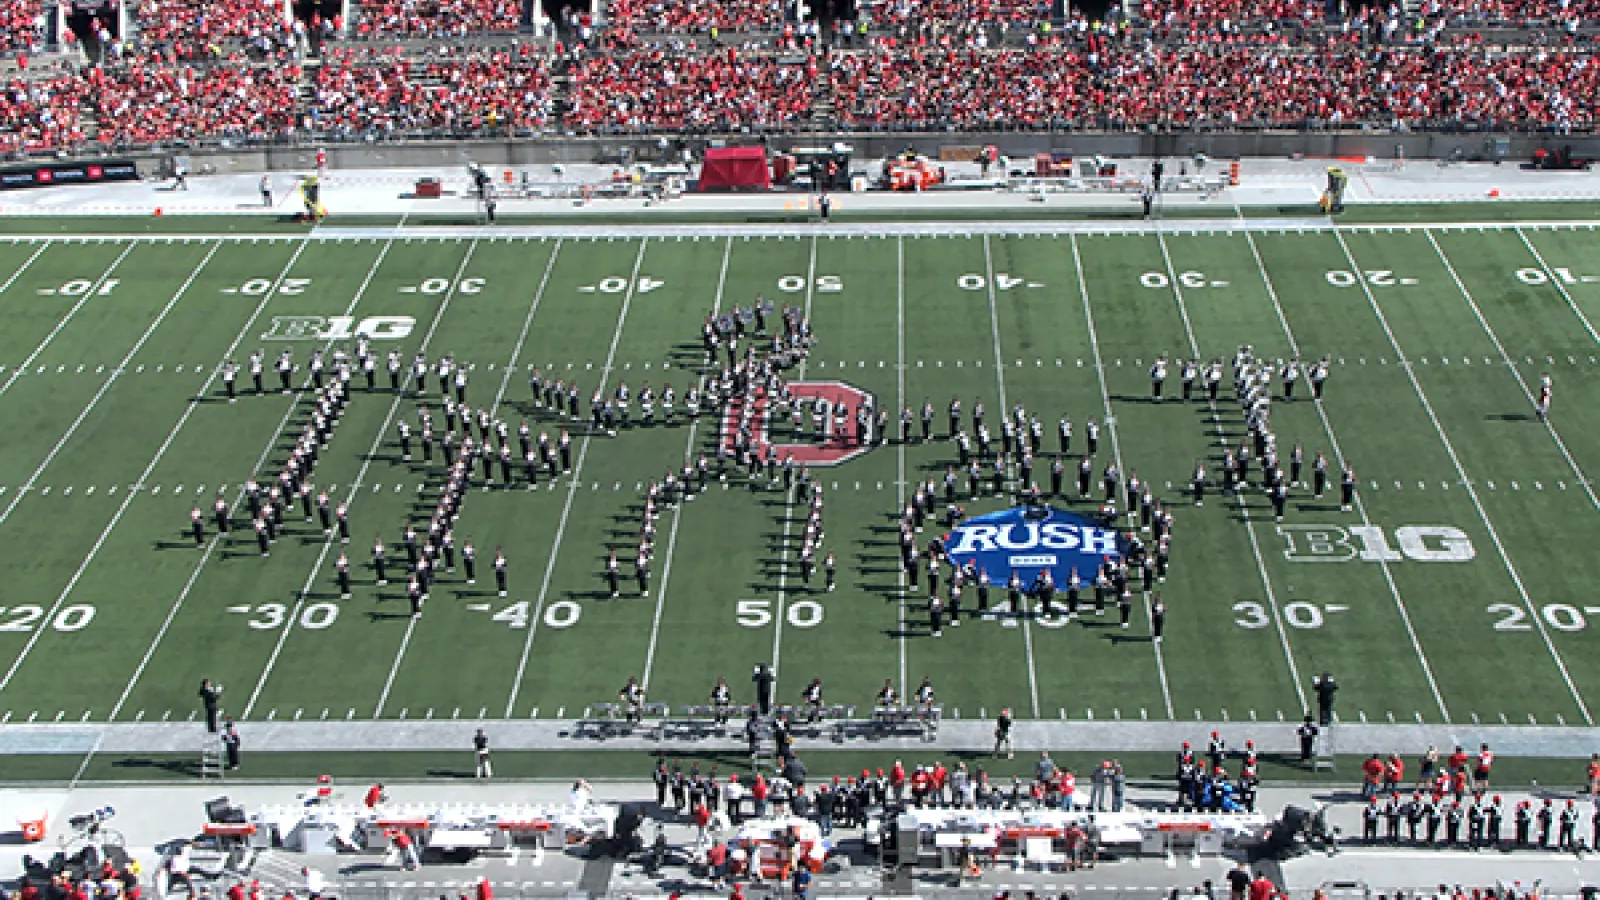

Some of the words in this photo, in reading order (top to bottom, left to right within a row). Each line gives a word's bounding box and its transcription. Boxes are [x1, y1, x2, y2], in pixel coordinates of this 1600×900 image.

[599, 275, 665, 292] 40
[778, 275, 843, 292] 50
[958, 273, 1024, 290] 40
[1140, 271, 1206, 288] 30
[1325, 270, 1396, 287] 20
[1514, 267, 1577, 285] 10
[59, 279, 120, 295] 10
[240, 278, 312, 295] 20
[420, 278, 486, 293] 30
[951, 523, 1118, 555] RUSH
[0, 604, 97, 632] 20
[248, 603, 340, 629] 30
[491, 601, 583, 628] 40
[735, 600, 824, 628] 50
[1232, 601, 1324, 629] 30
[1485, 603, 1587, 631] 20
